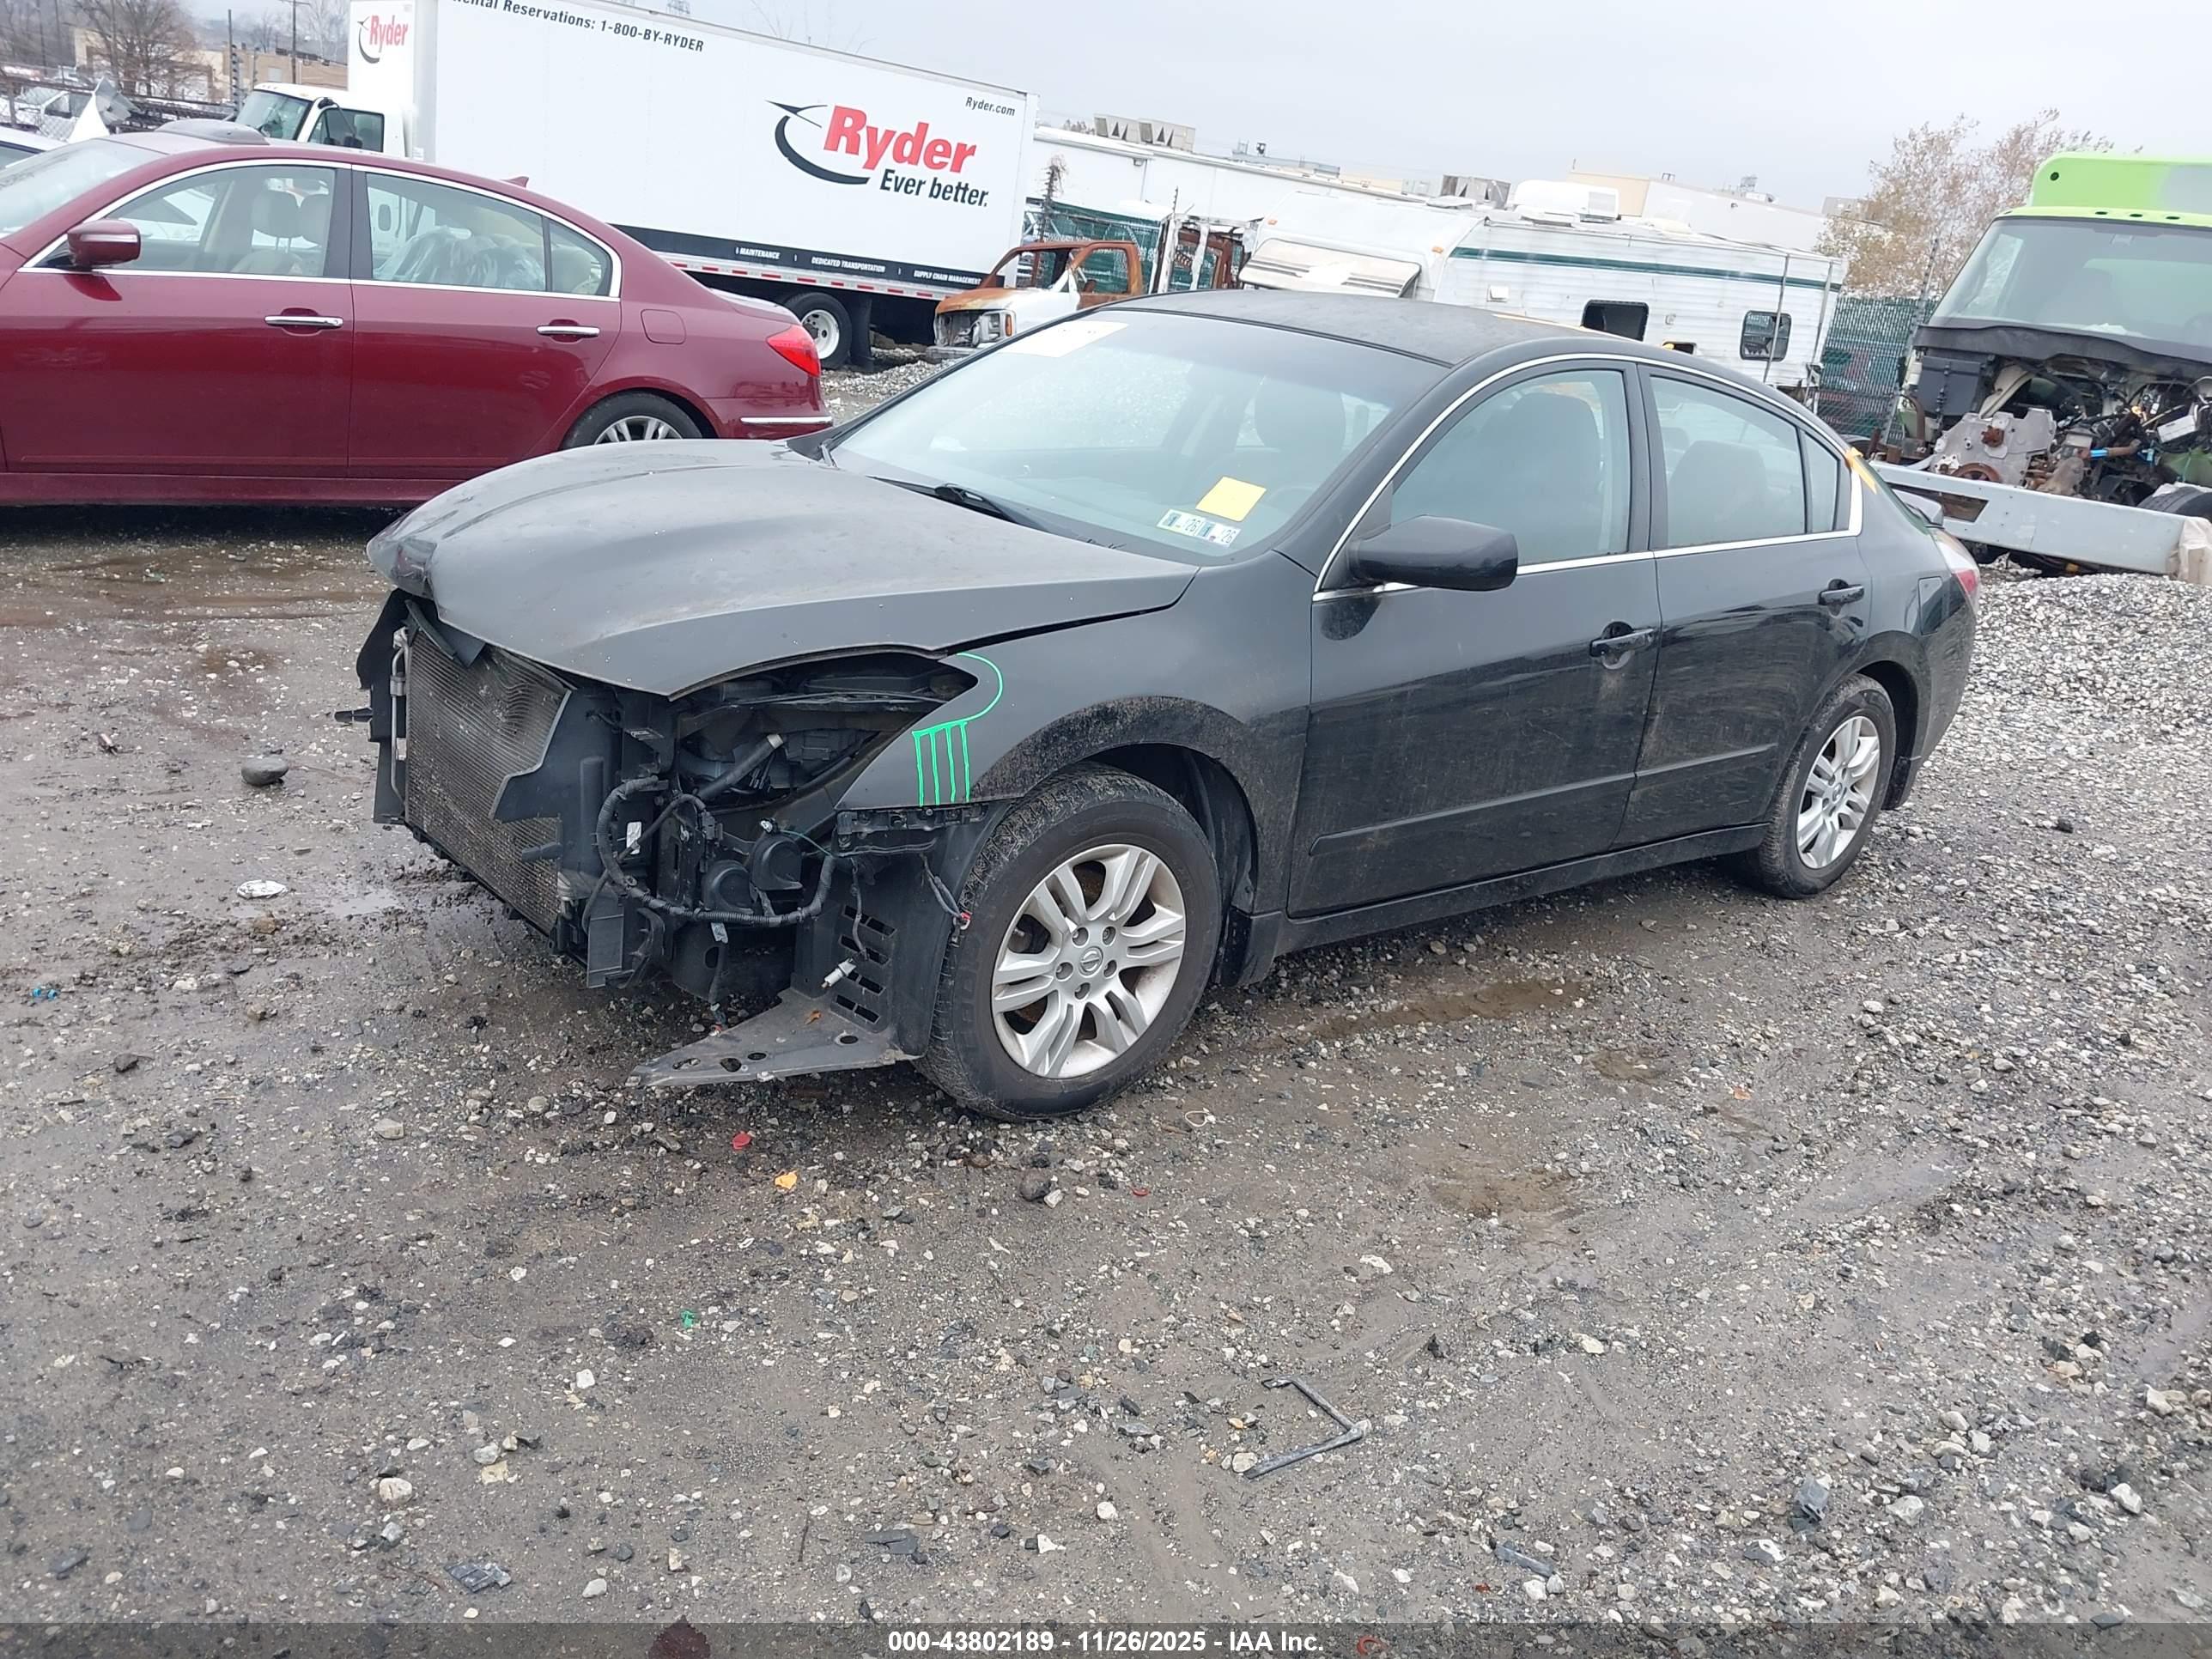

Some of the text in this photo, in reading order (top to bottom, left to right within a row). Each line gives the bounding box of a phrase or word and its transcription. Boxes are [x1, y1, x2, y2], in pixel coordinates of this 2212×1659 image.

[369, 15, 409, 53] Ryder
[504, 0, 595, 30] Reservations:
[600, 20, 704, 52] 1-800-BY-RYDER
[965, 96, 1016, 117] Ryder.com
[823, 104, 977, 173] Ryder
[879, 168, 989, 208] Ever better.
[739, 247, 982, 285] MAINTENANCE DEDICATED TRANSPORTATION SUPPLY CHAIN MANAGEMENT
